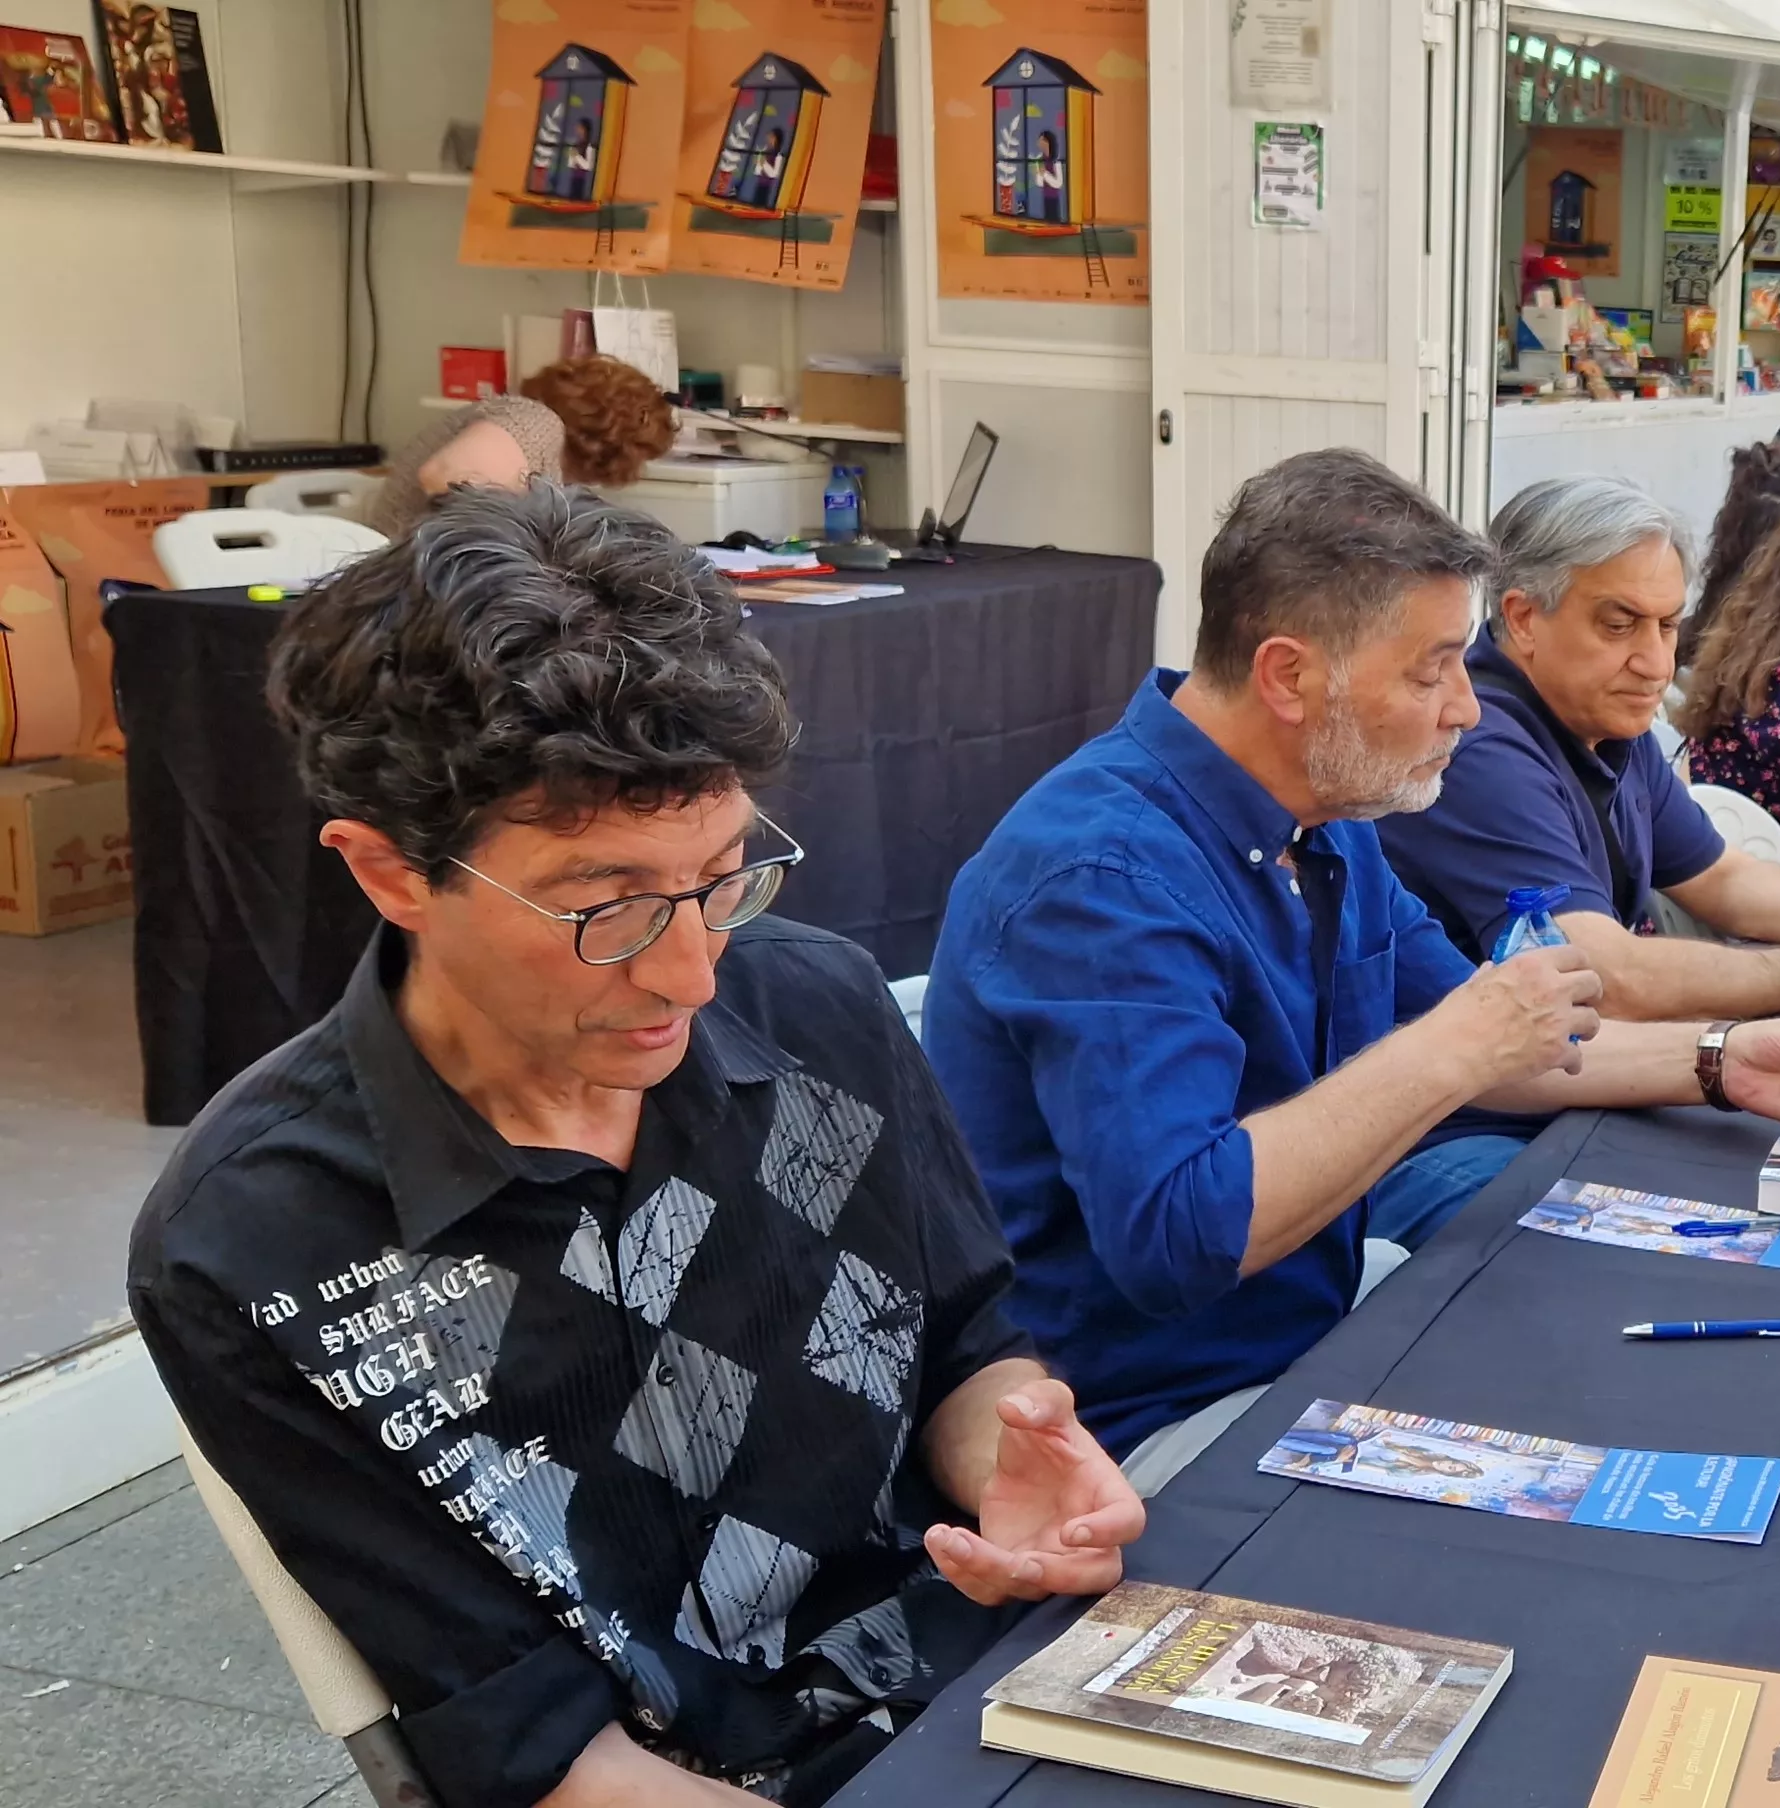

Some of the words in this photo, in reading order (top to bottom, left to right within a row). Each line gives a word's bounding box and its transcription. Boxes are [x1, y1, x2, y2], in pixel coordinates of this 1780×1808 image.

[250, 1290, 300, 1329] ad
[317, 1252, 404, 1304] urban
[318, 1254, 494, 1357] SURFACE
[306, 1332, 437, 1411] UGH
[380, 1372, 492, 1451] GEAR
[1124, 1620, 1216, 1690] DESCONOCIDA
[1652, 1740, 1673, 1765] Rafael
